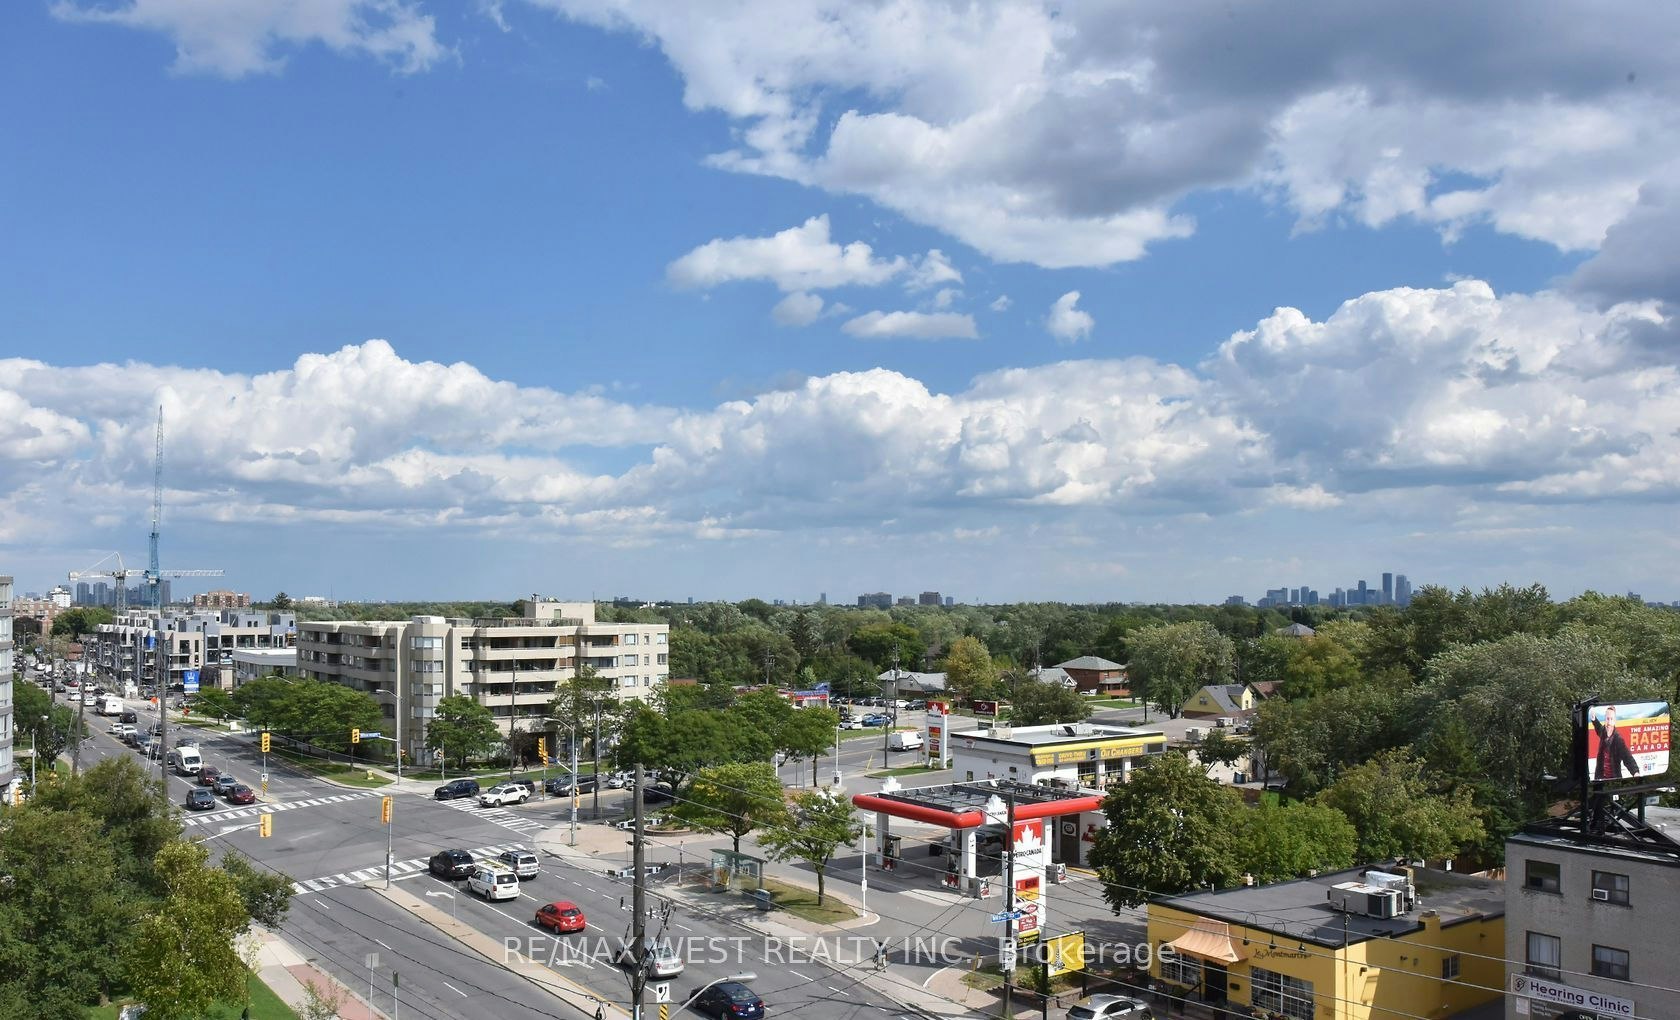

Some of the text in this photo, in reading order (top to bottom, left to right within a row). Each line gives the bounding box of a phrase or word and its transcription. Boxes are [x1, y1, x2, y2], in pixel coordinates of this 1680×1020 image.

[1630, 731, 1669, 745] RACE
[1630, 743, 1669, 751] CANADA
[1530, 981, 1585, 1004] Hearing
[1589, 996, 1630, 1013] Clinic
